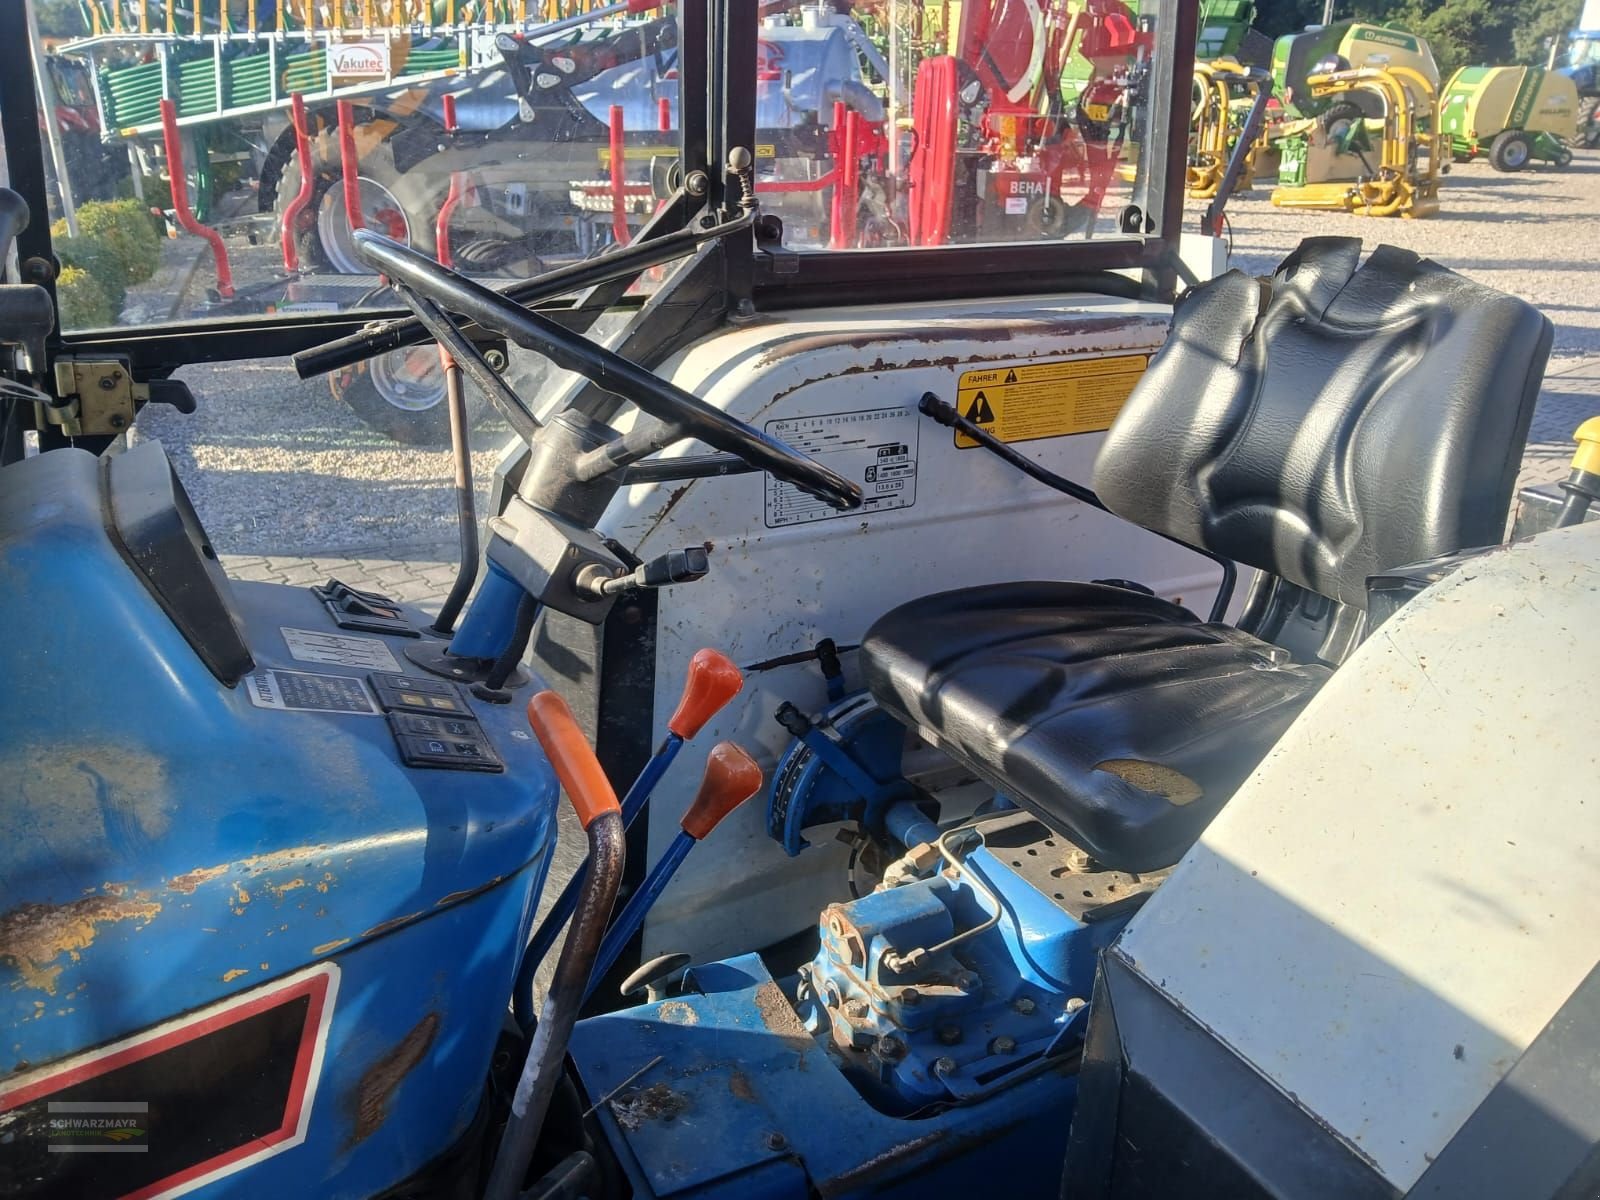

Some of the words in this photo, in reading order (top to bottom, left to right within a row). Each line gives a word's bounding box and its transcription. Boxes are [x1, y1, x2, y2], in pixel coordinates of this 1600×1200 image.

[333, 54, 383, 73] Vakutec
[1009, 181, 1043, 194] BEHA
[968, 373, 998, 384] FAHRER
